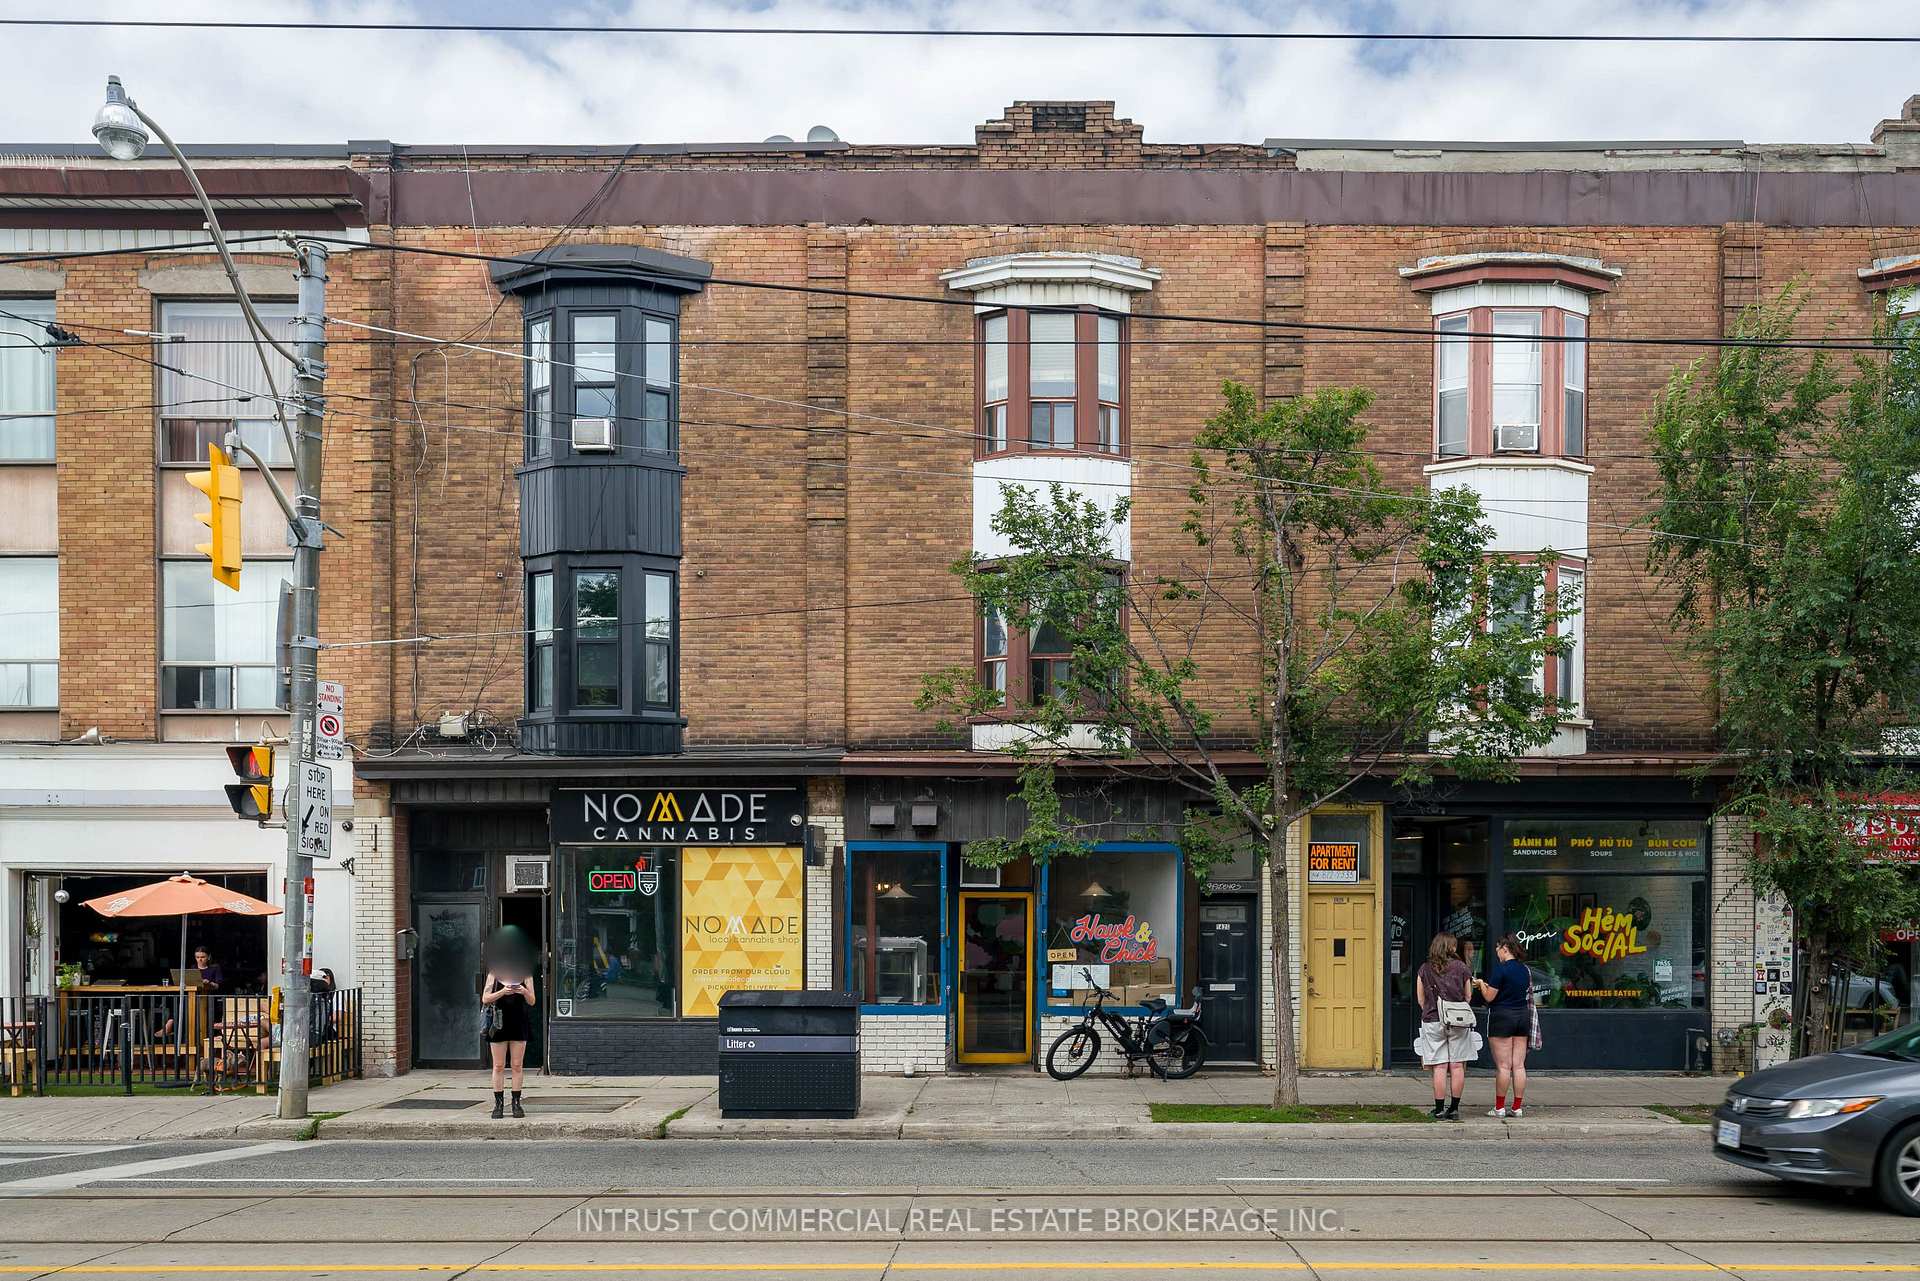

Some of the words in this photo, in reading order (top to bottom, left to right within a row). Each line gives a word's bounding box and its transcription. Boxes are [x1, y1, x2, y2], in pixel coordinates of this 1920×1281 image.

[325, 684, 335, 692] NO
[318, 693, 342, 704] STANDING
[308, 768, 326, 783] STOP
[306, 786, 326, 801] HERE
[319, 805, 330, 818] ON
[584, 792, 767, 823] NOMADE
[314, 821, 329, 834] RED
[593, 827, 756, 841] CANNABIS
[1311, 845, 1356, 857] APARTMENT
[1311, 858, 1329, 869] FOR
[1332, 858, 1356, 869] RENT
[591, 873, 635, 889] OPEN
[685, 914, 799, 934] NOMADE
[1071, 913, 1137, 942] Hawk
[1135, 921, 1152, 943] &
[709, 935, 731, 944] local
[734, 935, 775, 944] cannabis
[777, 936, 801, 946] shop
[1515, 930, 1557, 950] Open
[1101, 936, 1159, 964] Chick
[726, 1039, 748, 1049] Litter
